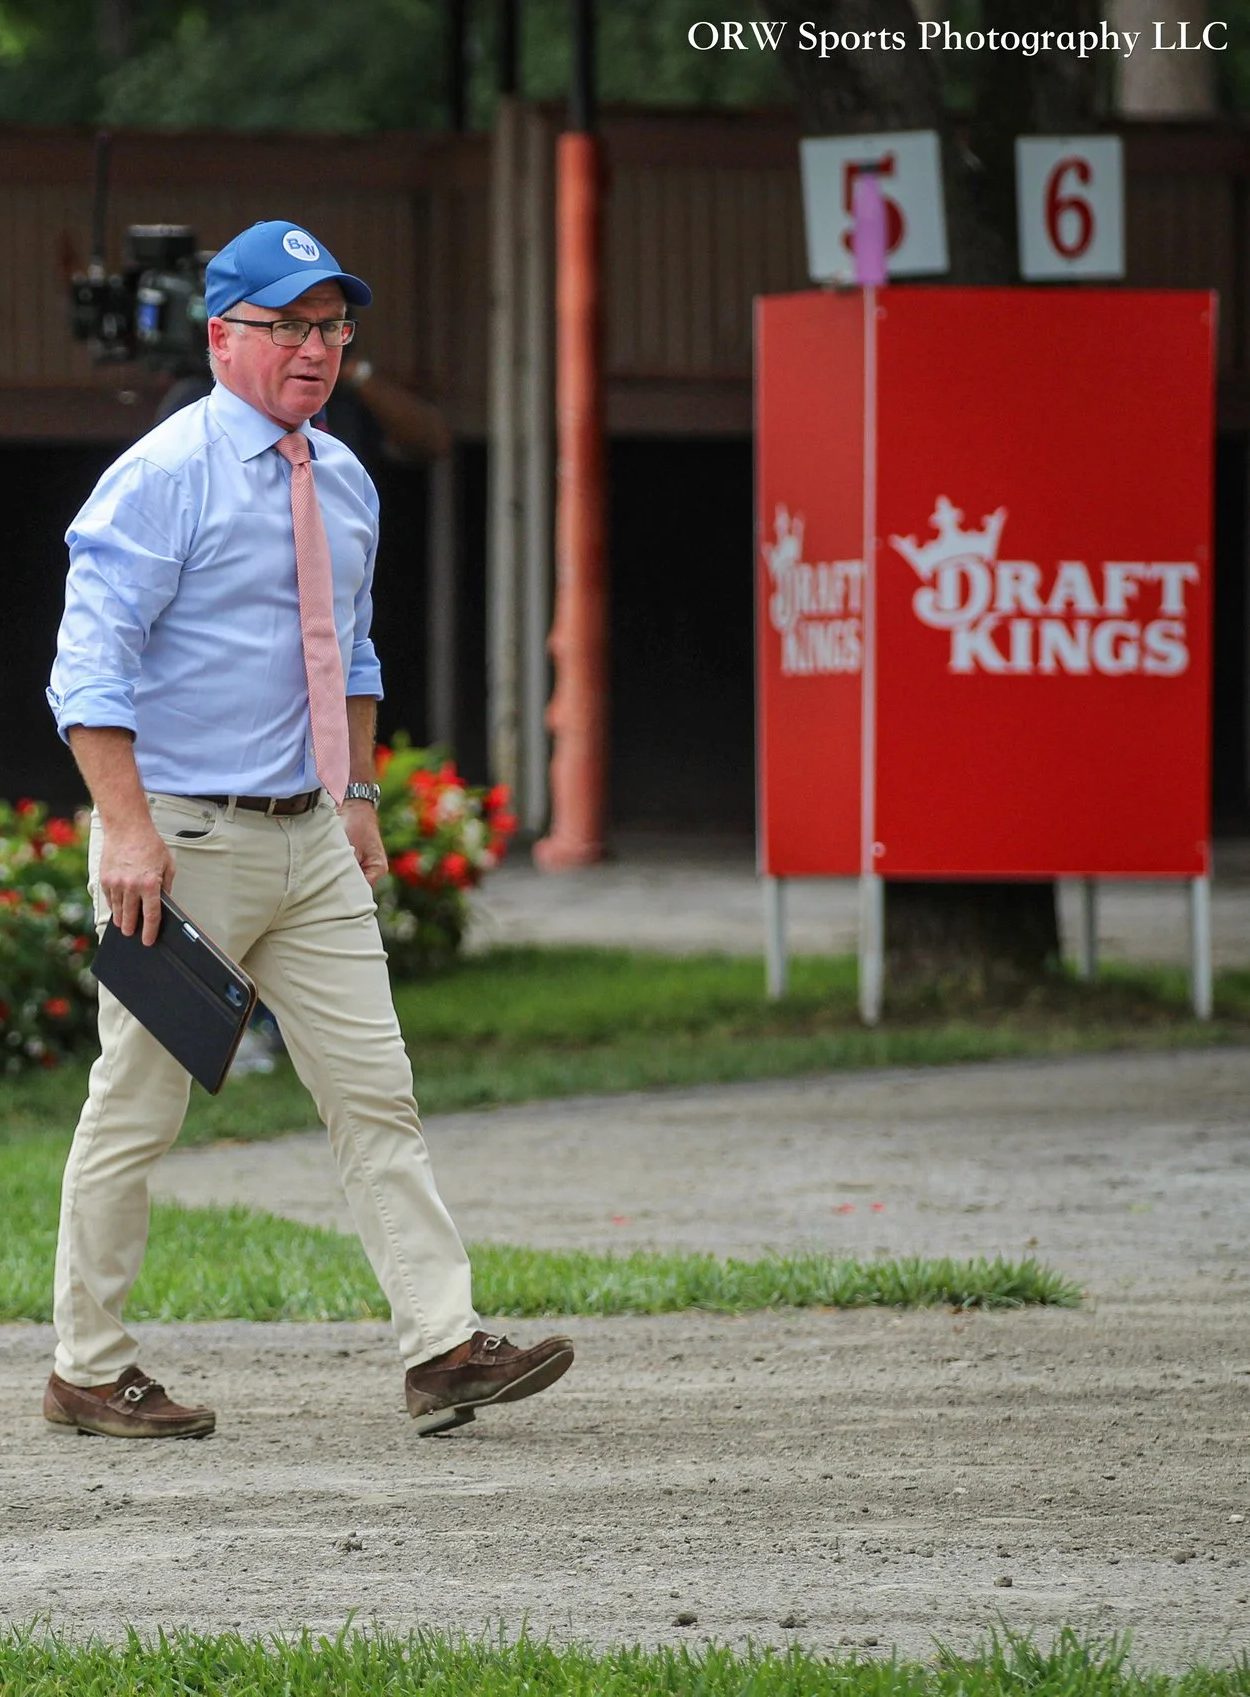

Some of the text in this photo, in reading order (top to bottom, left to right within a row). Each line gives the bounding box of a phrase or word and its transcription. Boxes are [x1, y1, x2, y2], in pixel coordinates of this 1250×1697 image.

[841, 149, 907, 257] 5
[1044, 155, 1094, 260] 6
[286, 238, 316, 257] BW
[912, 555, 1199, 629] DRAFT
[949, 612, 1189, 676] KINGS
